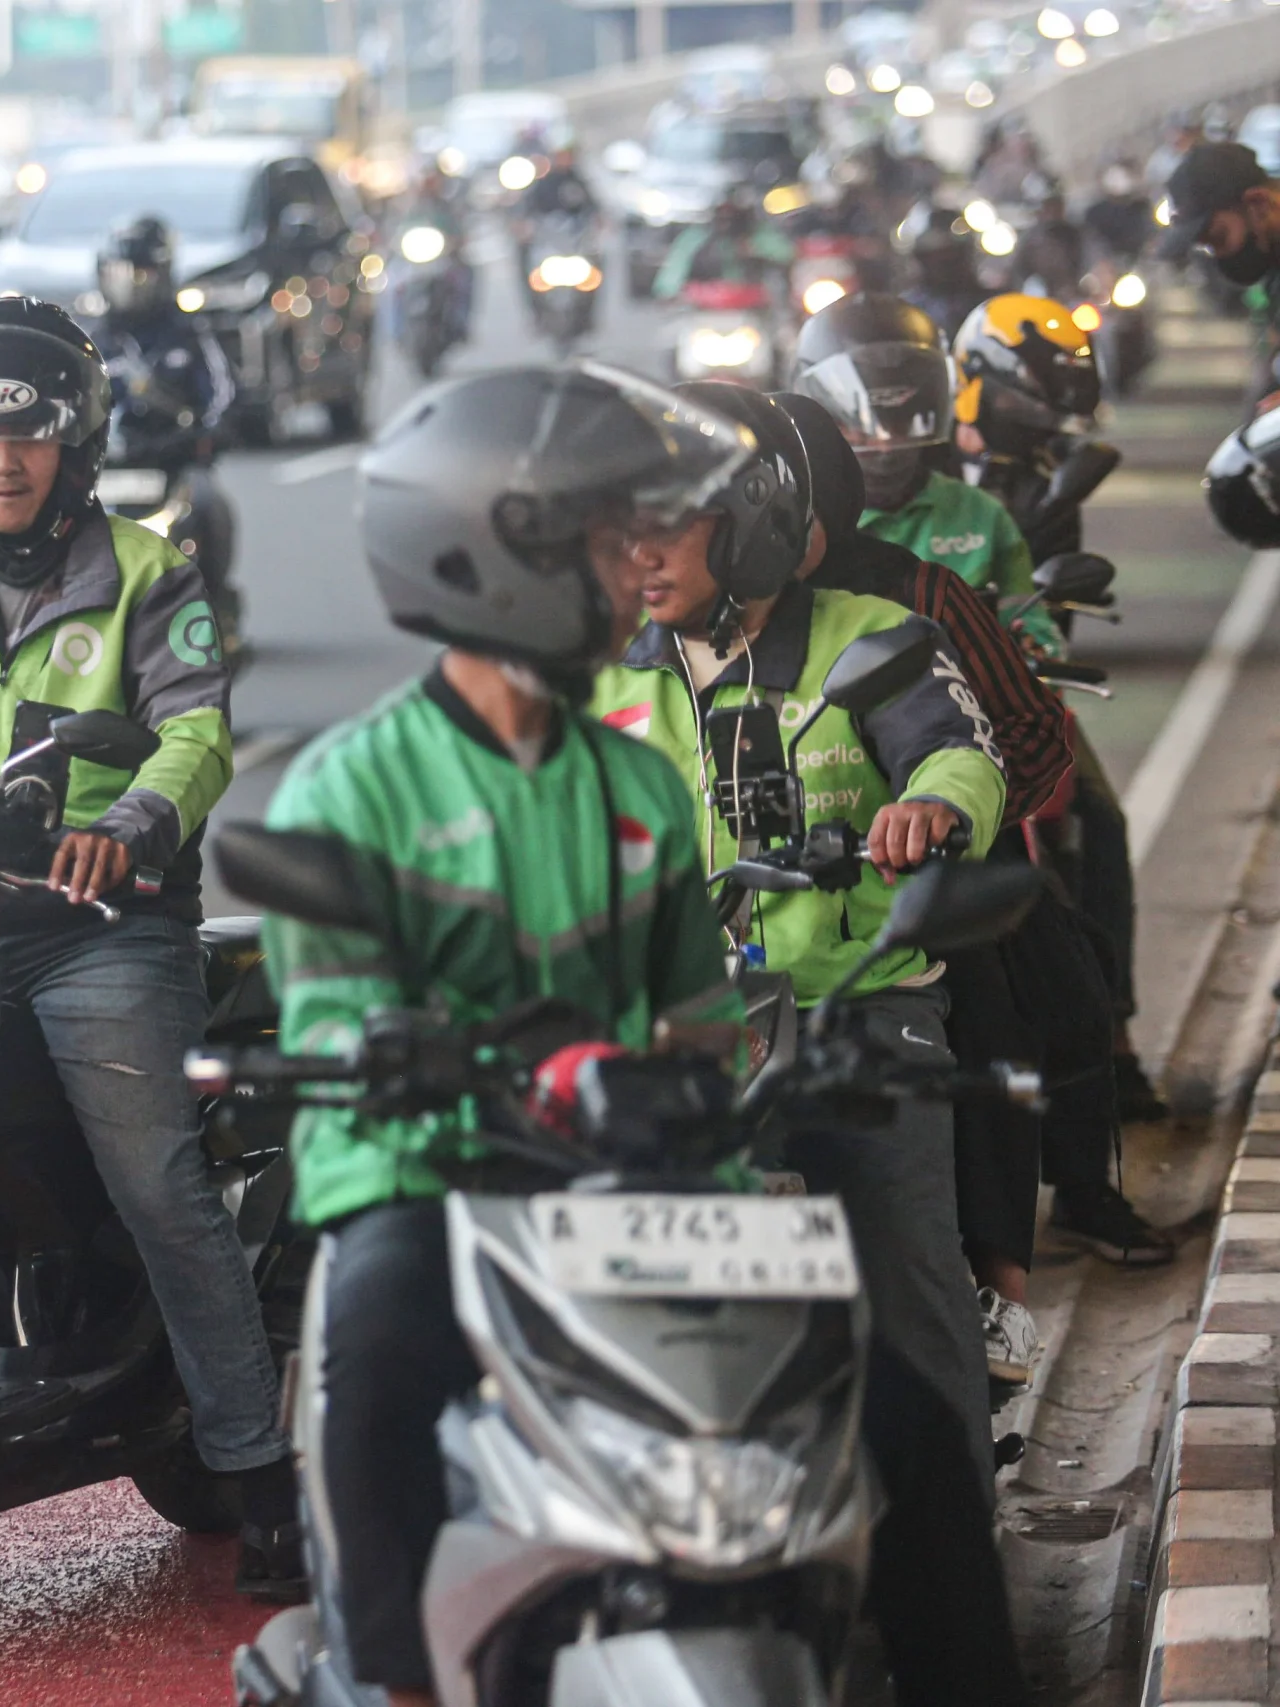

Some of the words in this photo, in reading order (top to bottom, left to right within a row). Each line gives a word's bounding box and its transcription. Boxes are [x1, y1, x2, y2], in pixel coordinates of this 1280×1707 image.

[796, 743, 865, 770] pedia
[805, 787, 863, 813] opay
[551, 1206, 575, 1240] A
[625, 1203, 741, 1243] 2745
